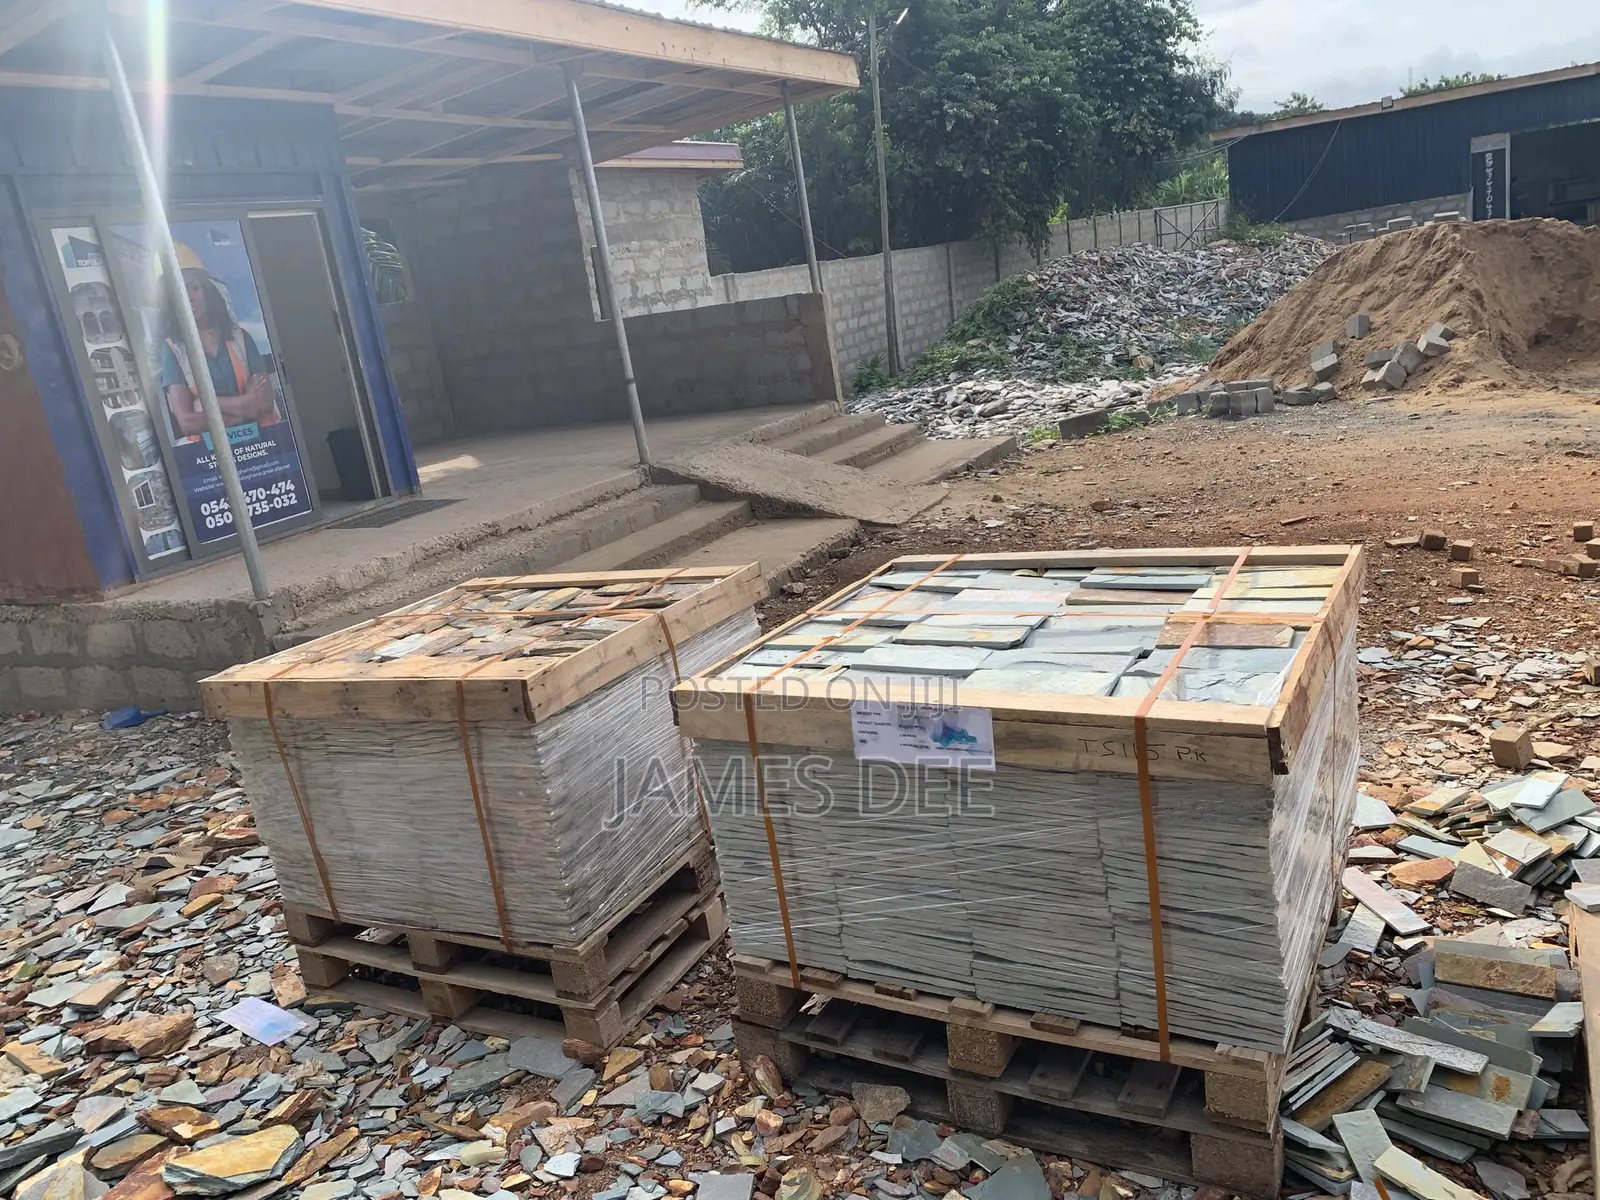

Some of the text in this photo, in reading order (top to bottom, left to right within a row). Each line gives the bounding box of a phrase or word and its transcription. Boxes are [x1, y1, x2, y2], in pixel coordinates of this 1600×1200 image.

[196, 456, 210, 465] ALL
[233, 447, 245, 455] OF
[244, 440, 277, 453] NATURAL
[237, 449, 269, 462] DESIGNS.
